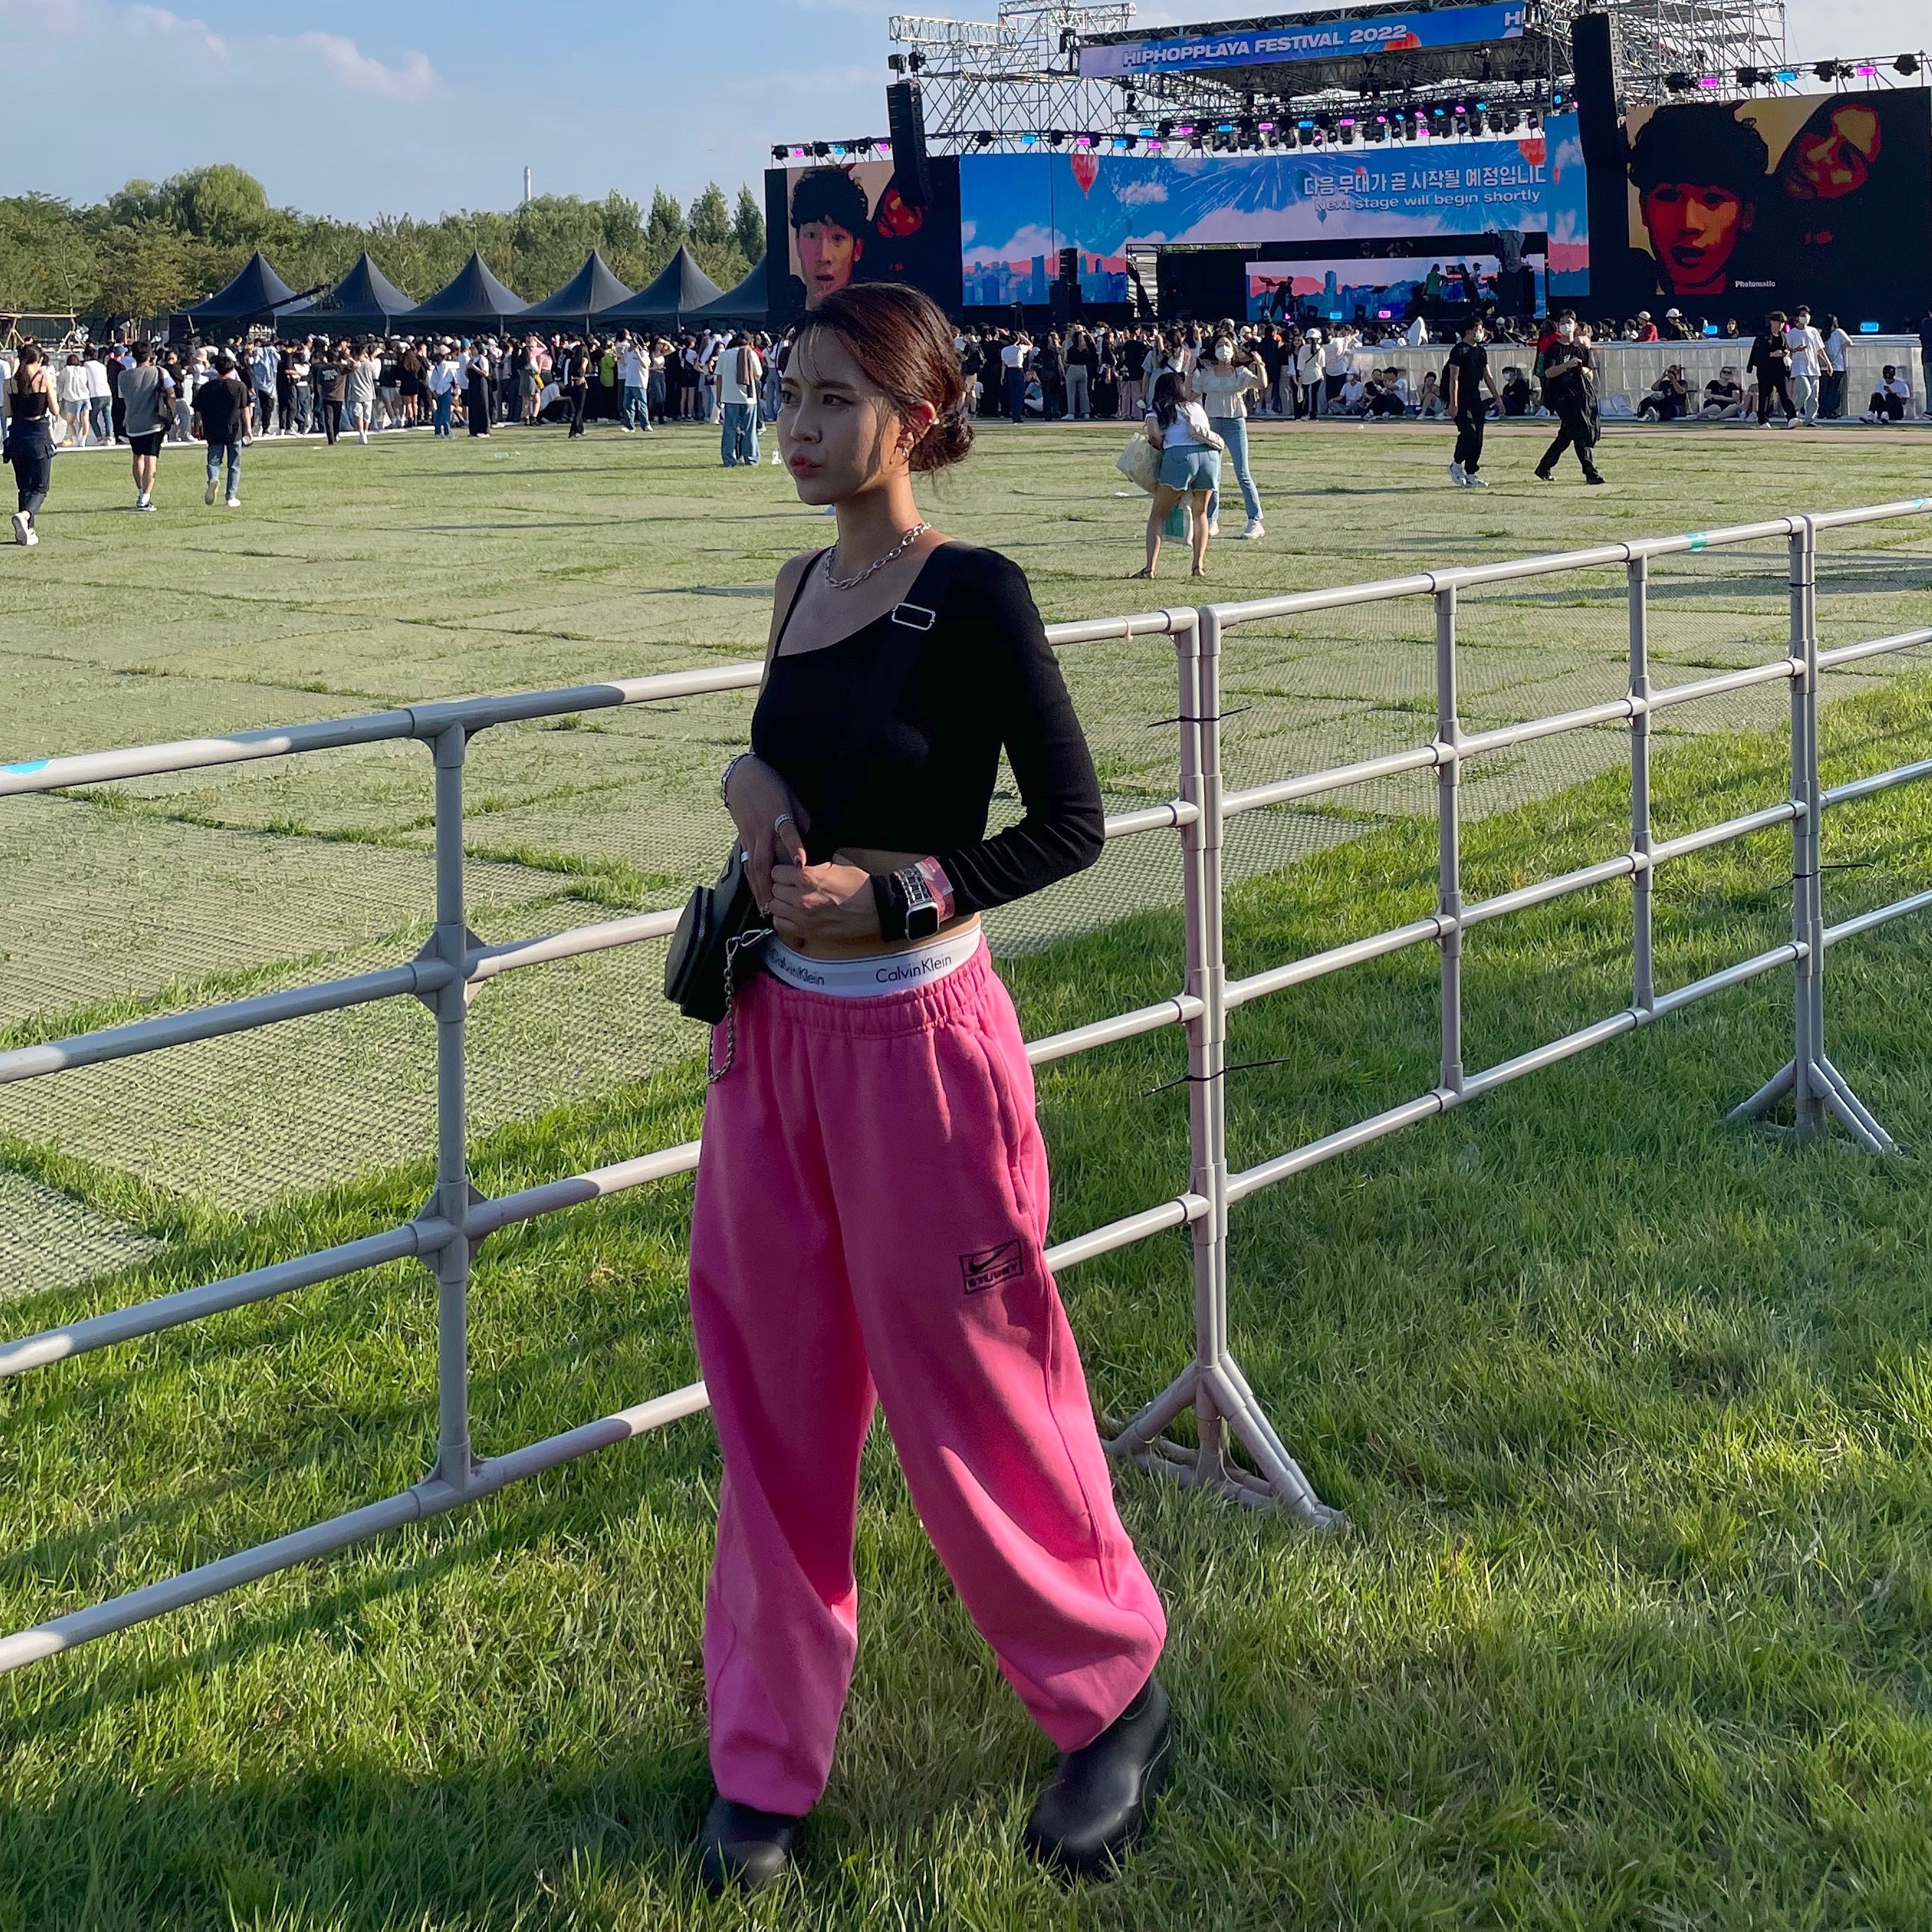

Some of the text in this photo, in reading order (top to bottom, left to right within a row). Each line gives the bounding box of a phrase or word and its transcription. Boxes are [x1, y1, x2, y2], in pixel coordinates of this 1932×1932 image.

[1123, 25, 1407, 66] HIPHOPPLAYA FESTIVAL 2022
[1304, 176, 1334, 195] 다음
[1339, 174, 1387, 194] 무대가
[1391, 172, 1407, 191] 곧
[1411, 169, 1461, 189] 시작될
[1315, 189, 1541, 211] Next stage will begin shortly
